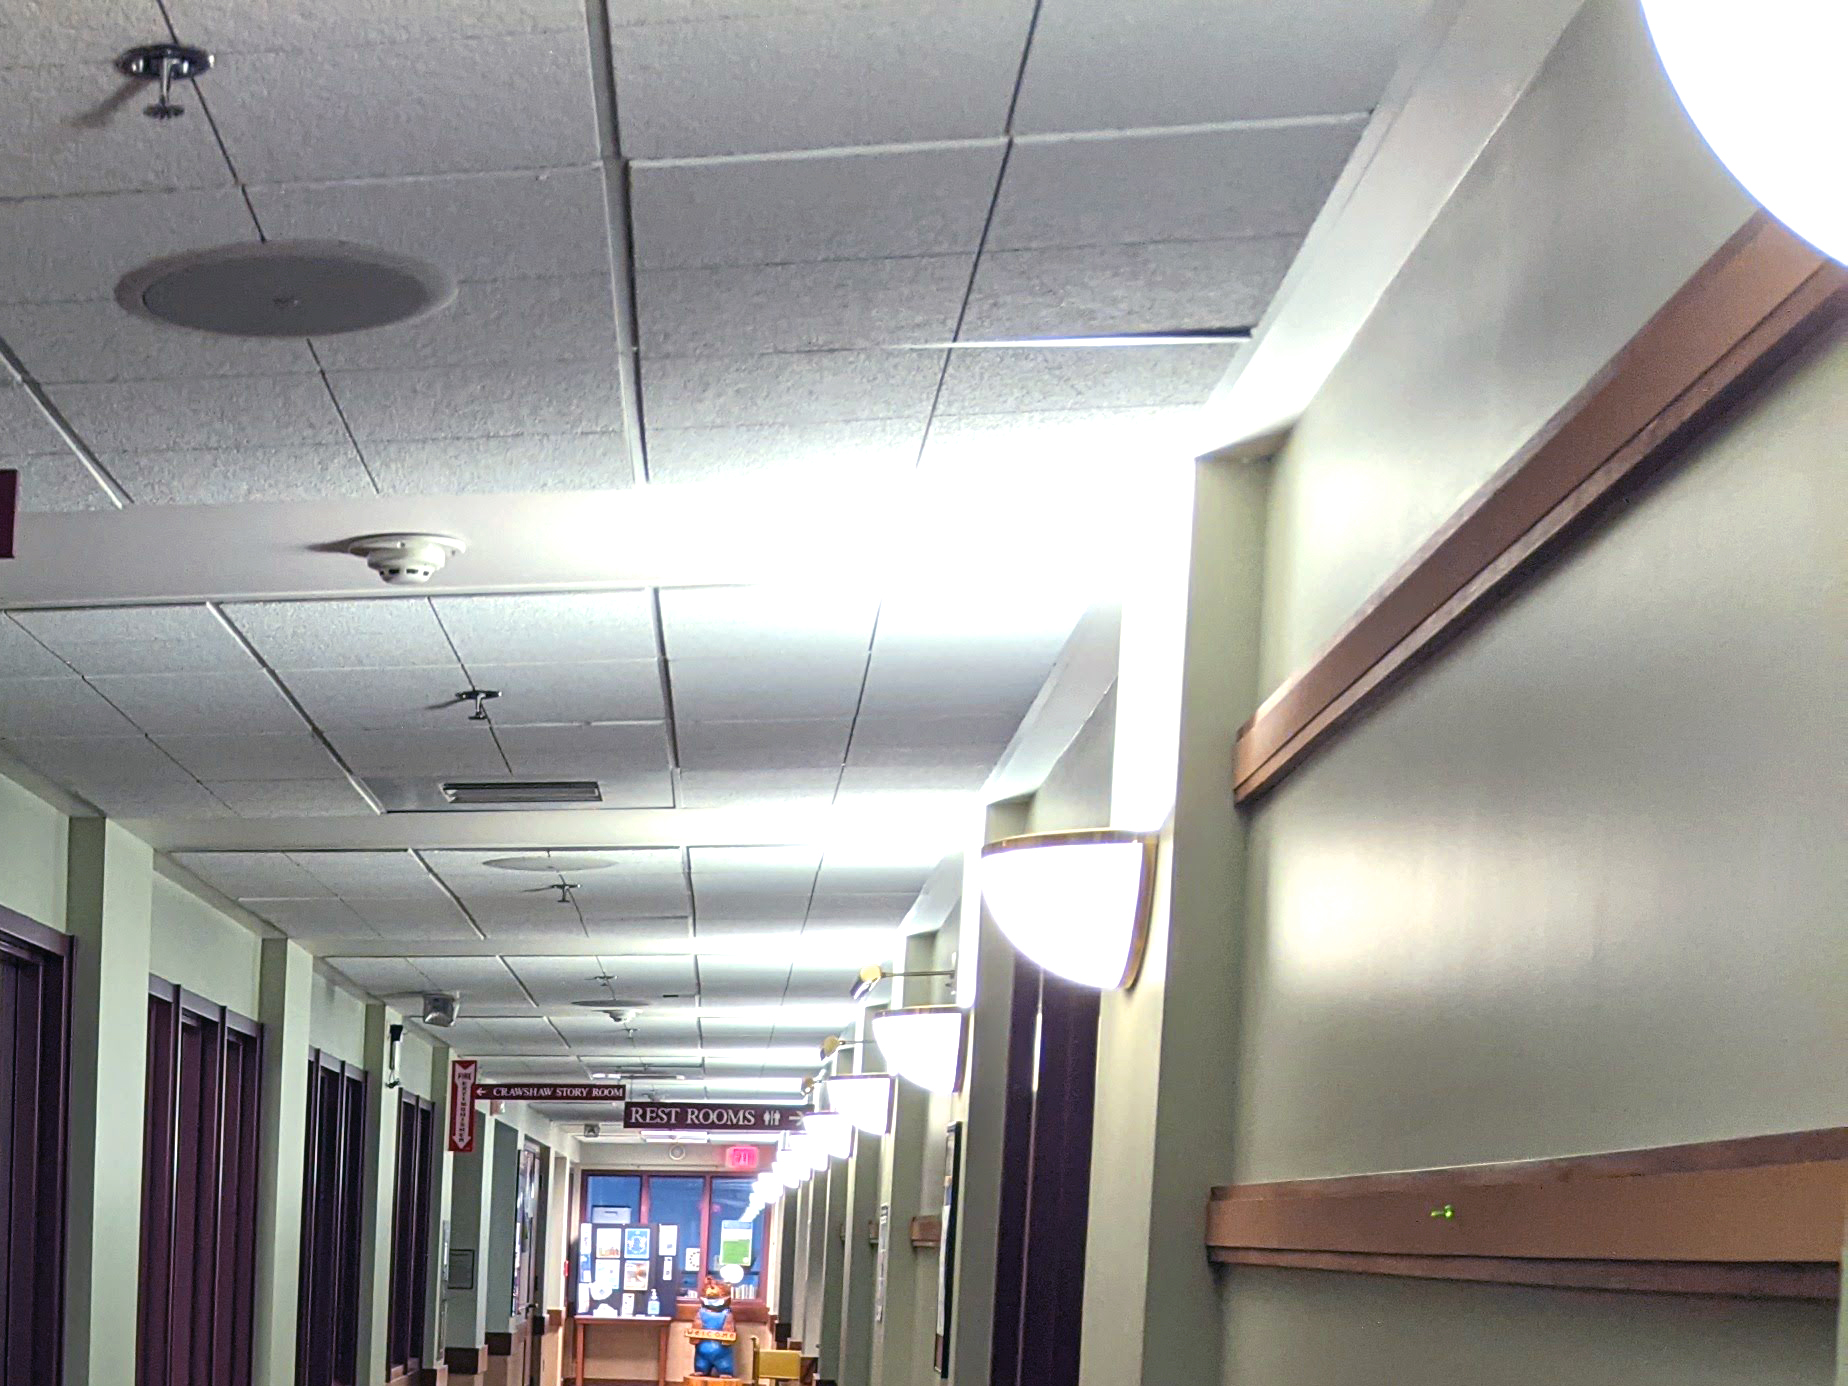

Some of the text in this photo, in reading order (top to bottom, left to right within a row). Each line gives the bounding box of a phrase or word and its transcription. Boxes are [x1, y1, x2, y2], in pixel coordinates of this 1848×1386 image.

[493, 1087, 623, 1097] CRAWSHAW STORY ROOM
[630, 1107, 755, 1125] REST ROOMS
